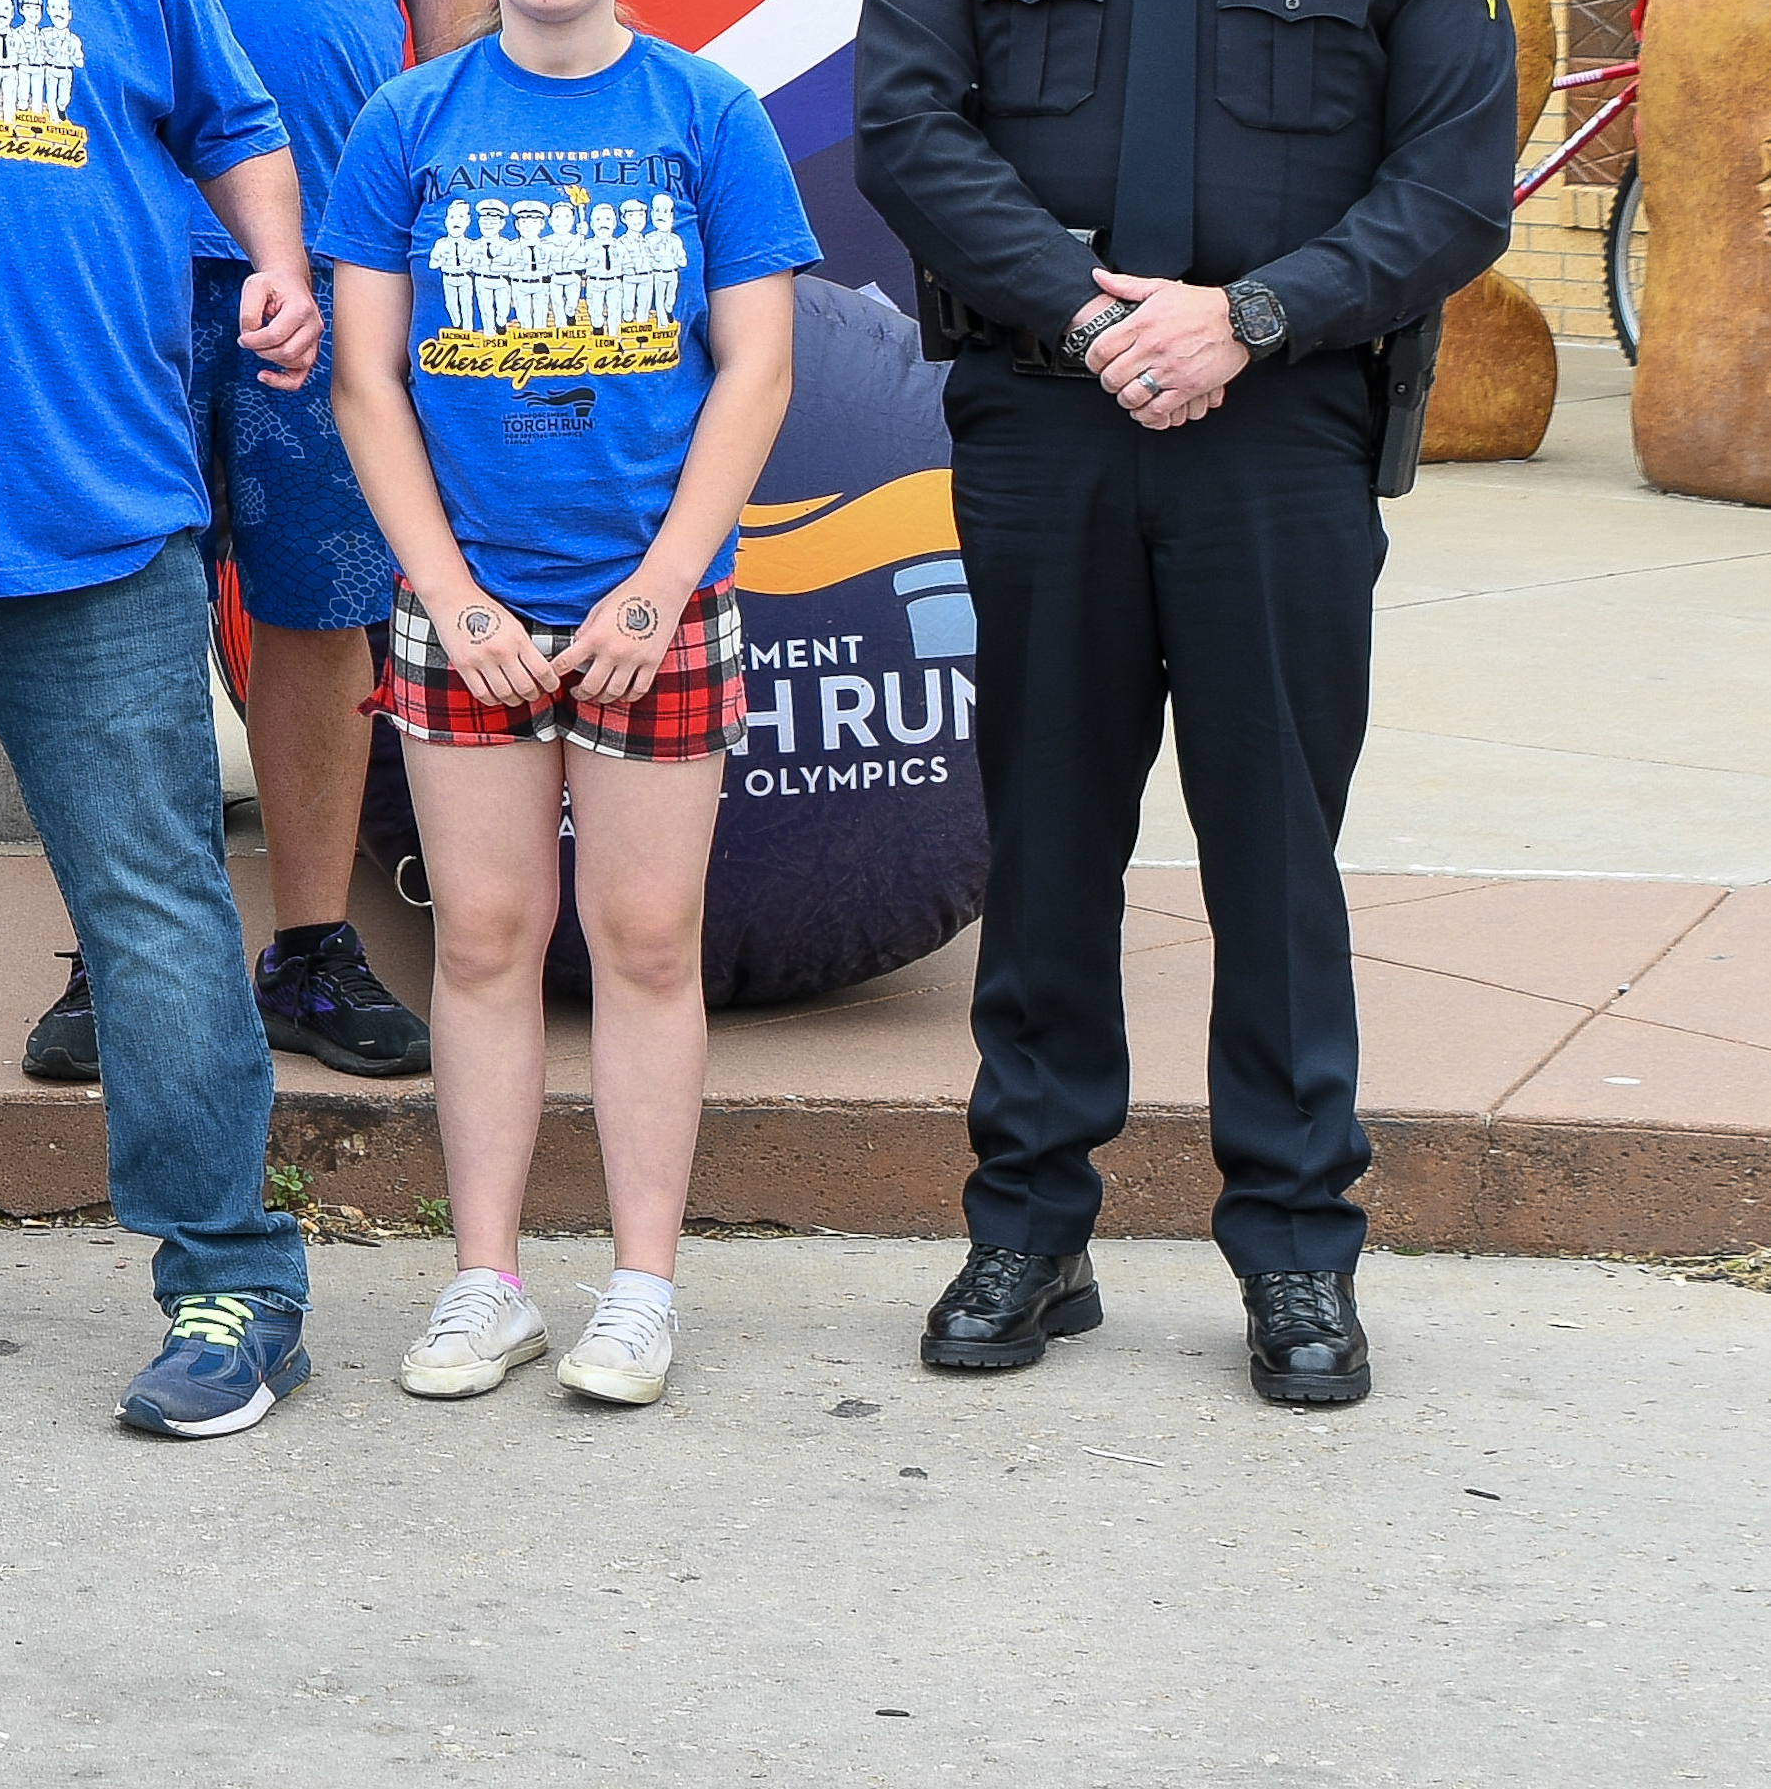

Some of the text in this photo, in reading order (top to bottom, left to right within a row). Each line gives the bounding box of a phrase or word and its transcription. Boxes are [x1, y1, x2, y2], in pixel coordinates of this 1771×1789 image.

[33, 139, 85, 164] made
[509, 148, 635, 162] ANNIVERSARY
[594, 154, 684, 200] LETR
[483, 337, 508, 348] IPSEN
[562, 329, 587, 340] MILES
[422, 343, 634, 381] Where legends are
[502, 418, 593, 434] TORCH RUN
[740, 635, 863, 671] MENT
[745, 756, 948, 797] OLYMPICS
